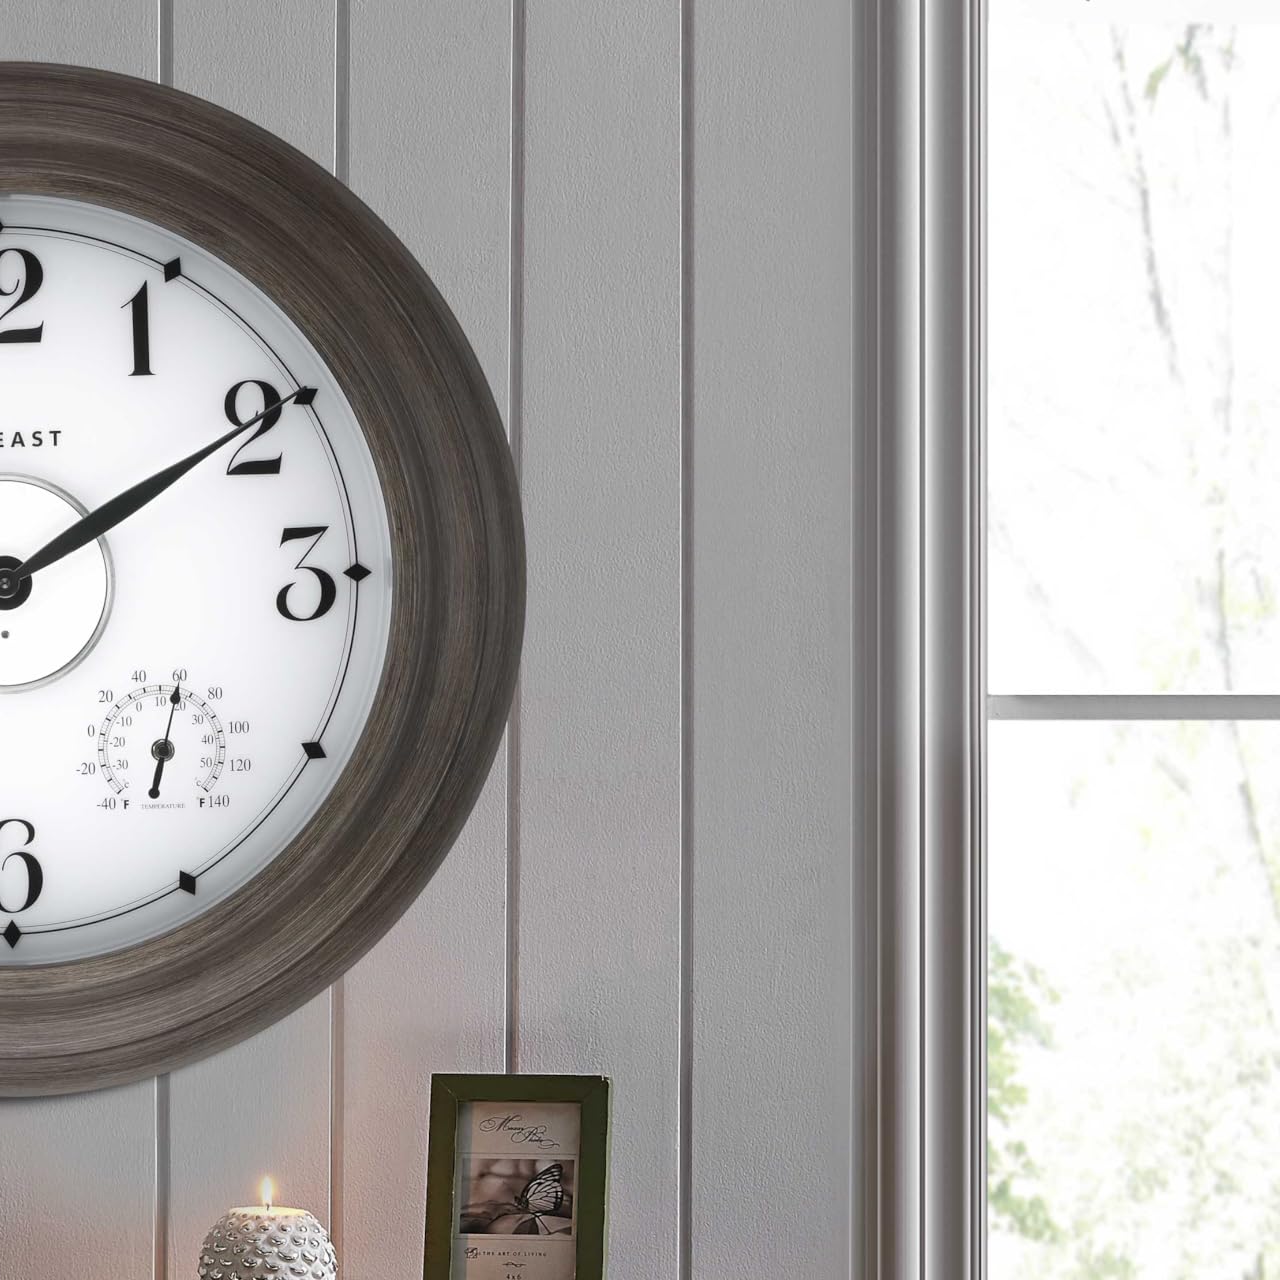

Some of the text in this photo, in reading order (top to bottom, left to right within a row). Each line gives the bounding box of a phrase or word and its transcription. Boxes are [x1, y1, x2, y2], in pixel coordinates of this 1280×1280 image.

[120, 280, 154, 376] 1
[223, 379, 284, 476] 2
[275, 526, 338, 623] 3
[131, 669, 147, 683] 40
[172, 668, 188, 683] 60
[98, 690, 113, 703] 20
[208, 687, 223, 700] 80
[135, 702, 143, 713] 0
[154, 696, 167, 708] 10
[191, 714, 204, 726] 30
[87, 724, 95, 737] 0
[229, 720, 250, 734] 100
[201, 734, 214, 746] 40
[75, 762, 96, 776] -20
[199, 757, 213, 769] 50
[230, 759, 251, 772] 120
[96, 797, 117, 810] -40
[208, 794, 231, 808] 140
